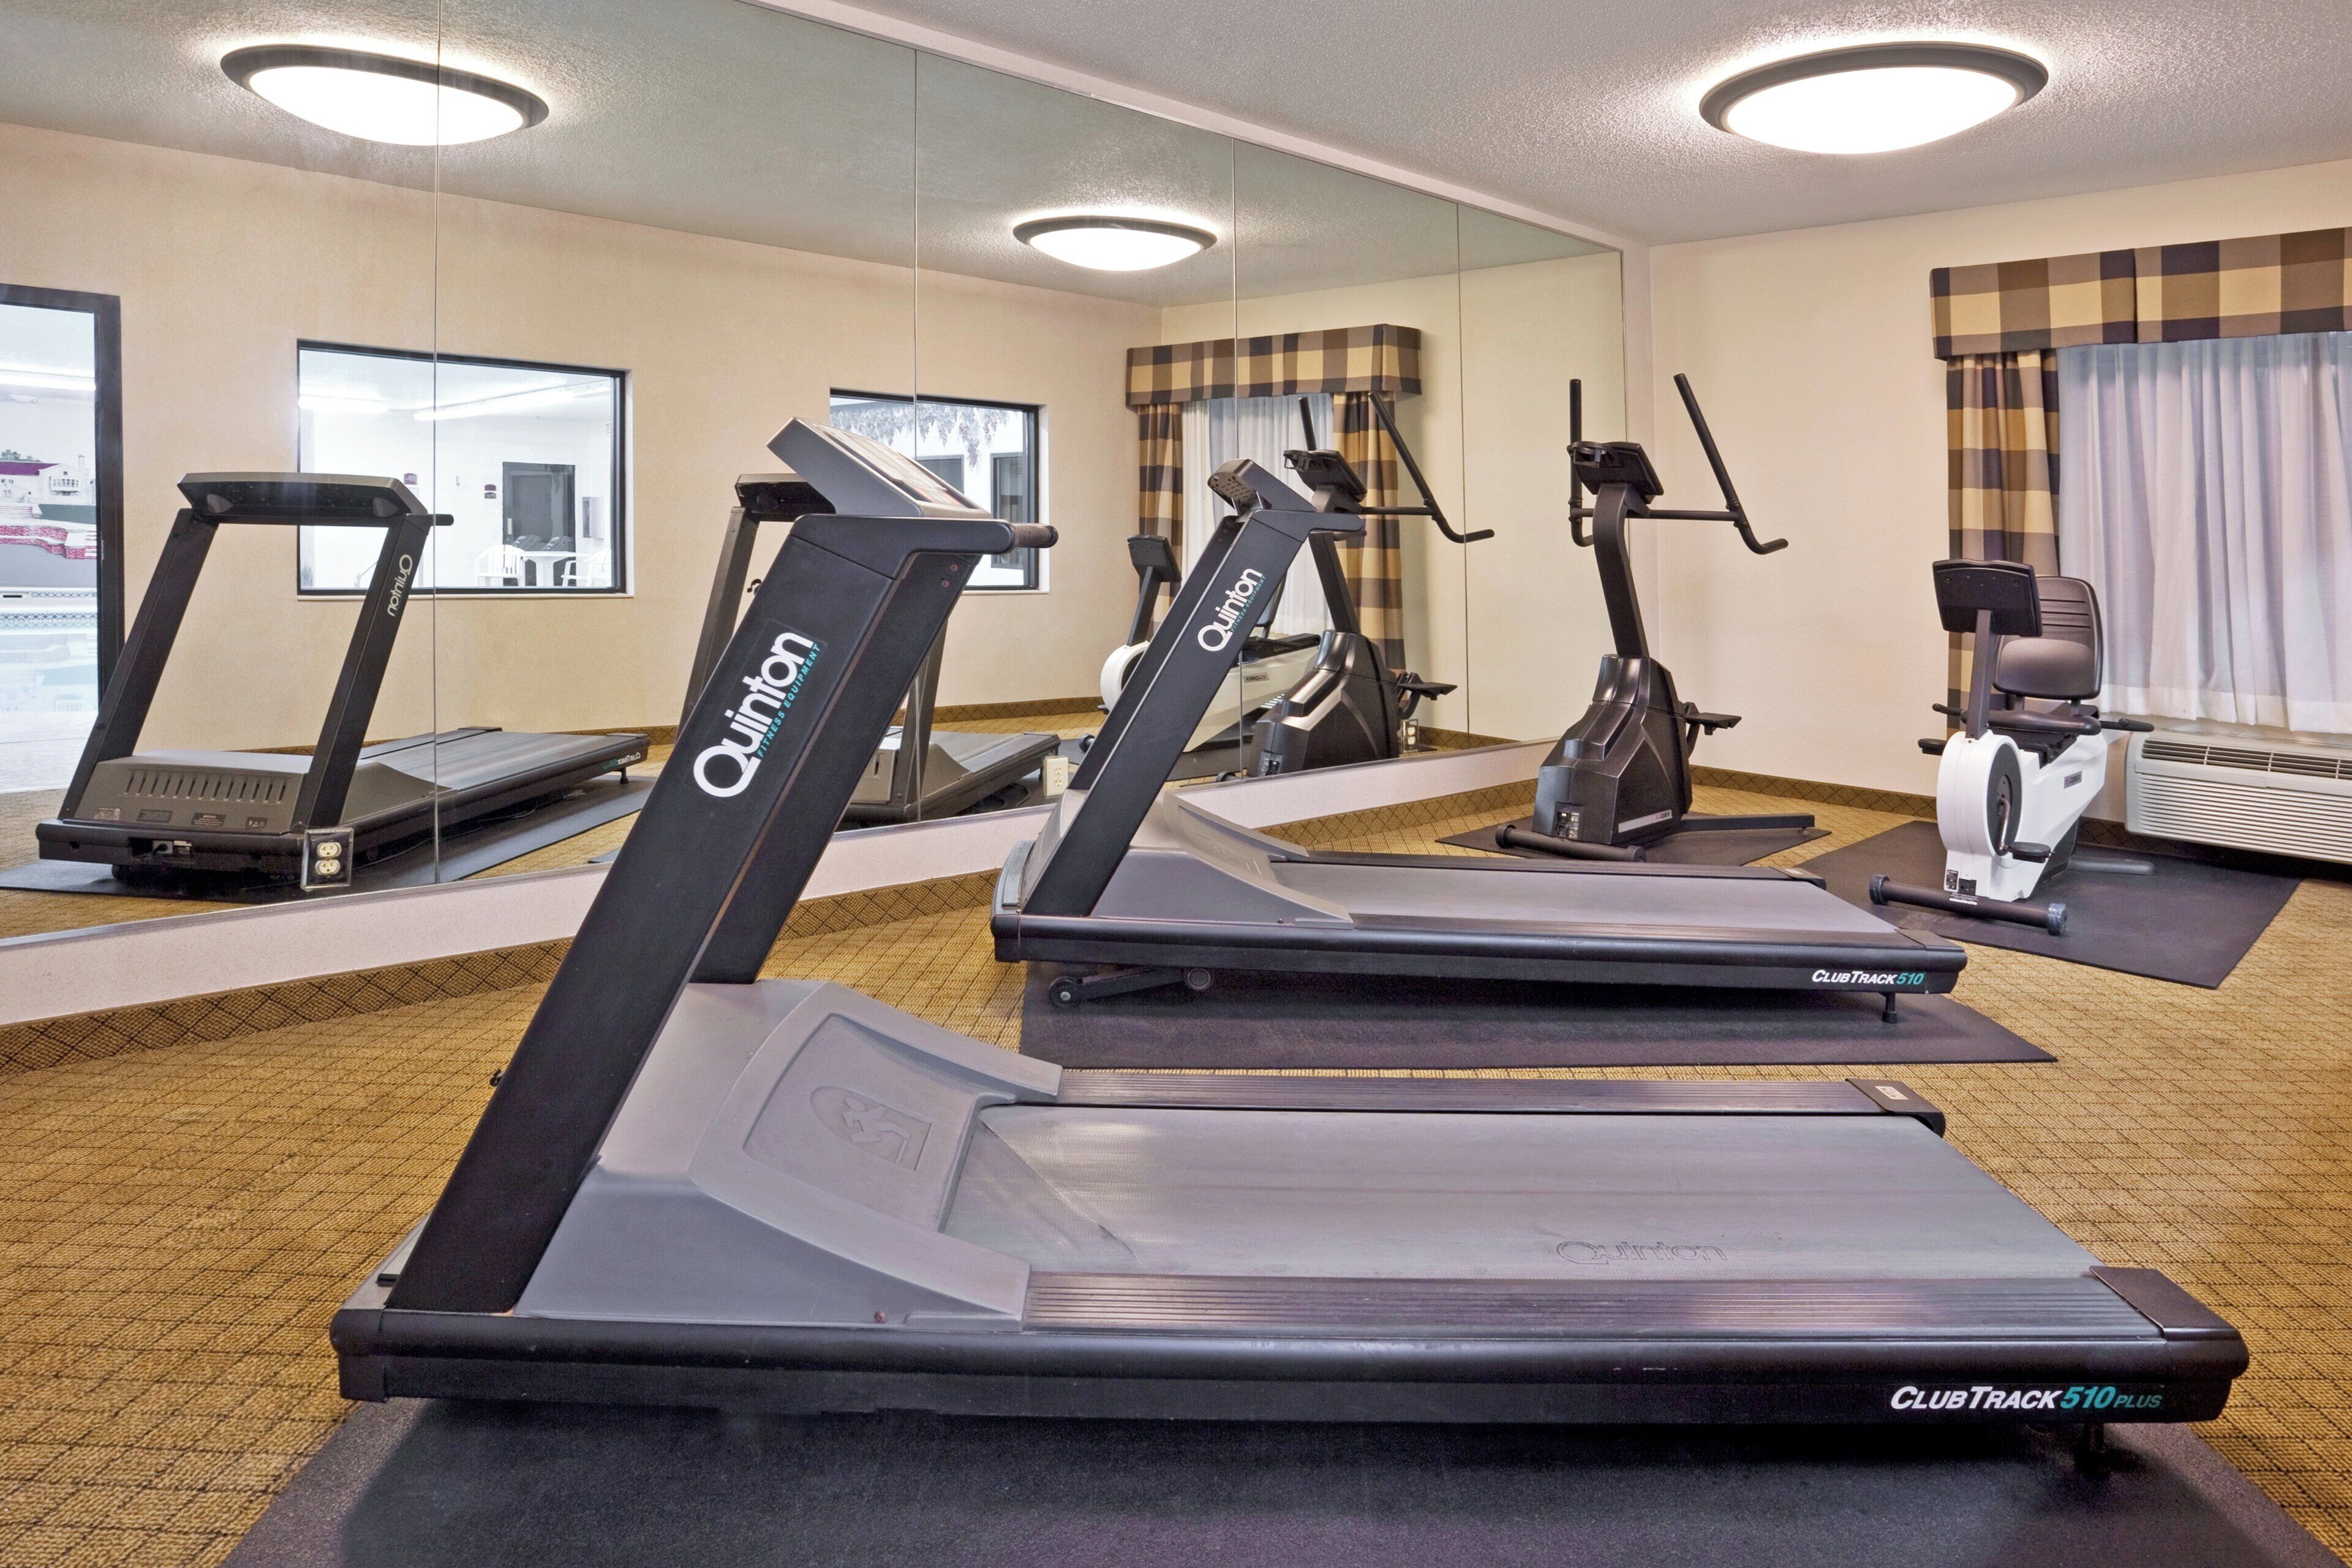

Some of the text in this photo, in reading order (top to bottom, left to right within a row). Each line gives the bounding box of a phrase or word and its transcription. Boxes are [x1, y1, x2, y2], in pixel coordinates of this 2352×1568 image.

[1197, 568, 1263, 652] Quinton
[1231, 575, 1266, 633] FITNESS EQUIPMENT
[693, 632, 814, 797] Quinton
[757, 643, 820, 758] FITNESS EQUIPMENT
[1896, 973, 1925, 985] 510
[1556, 1241, 1728, 1265] Quinton
[2060, 1386, 2116, 1409] 510
[2113, 1395, 2163, 1409] PLUS
